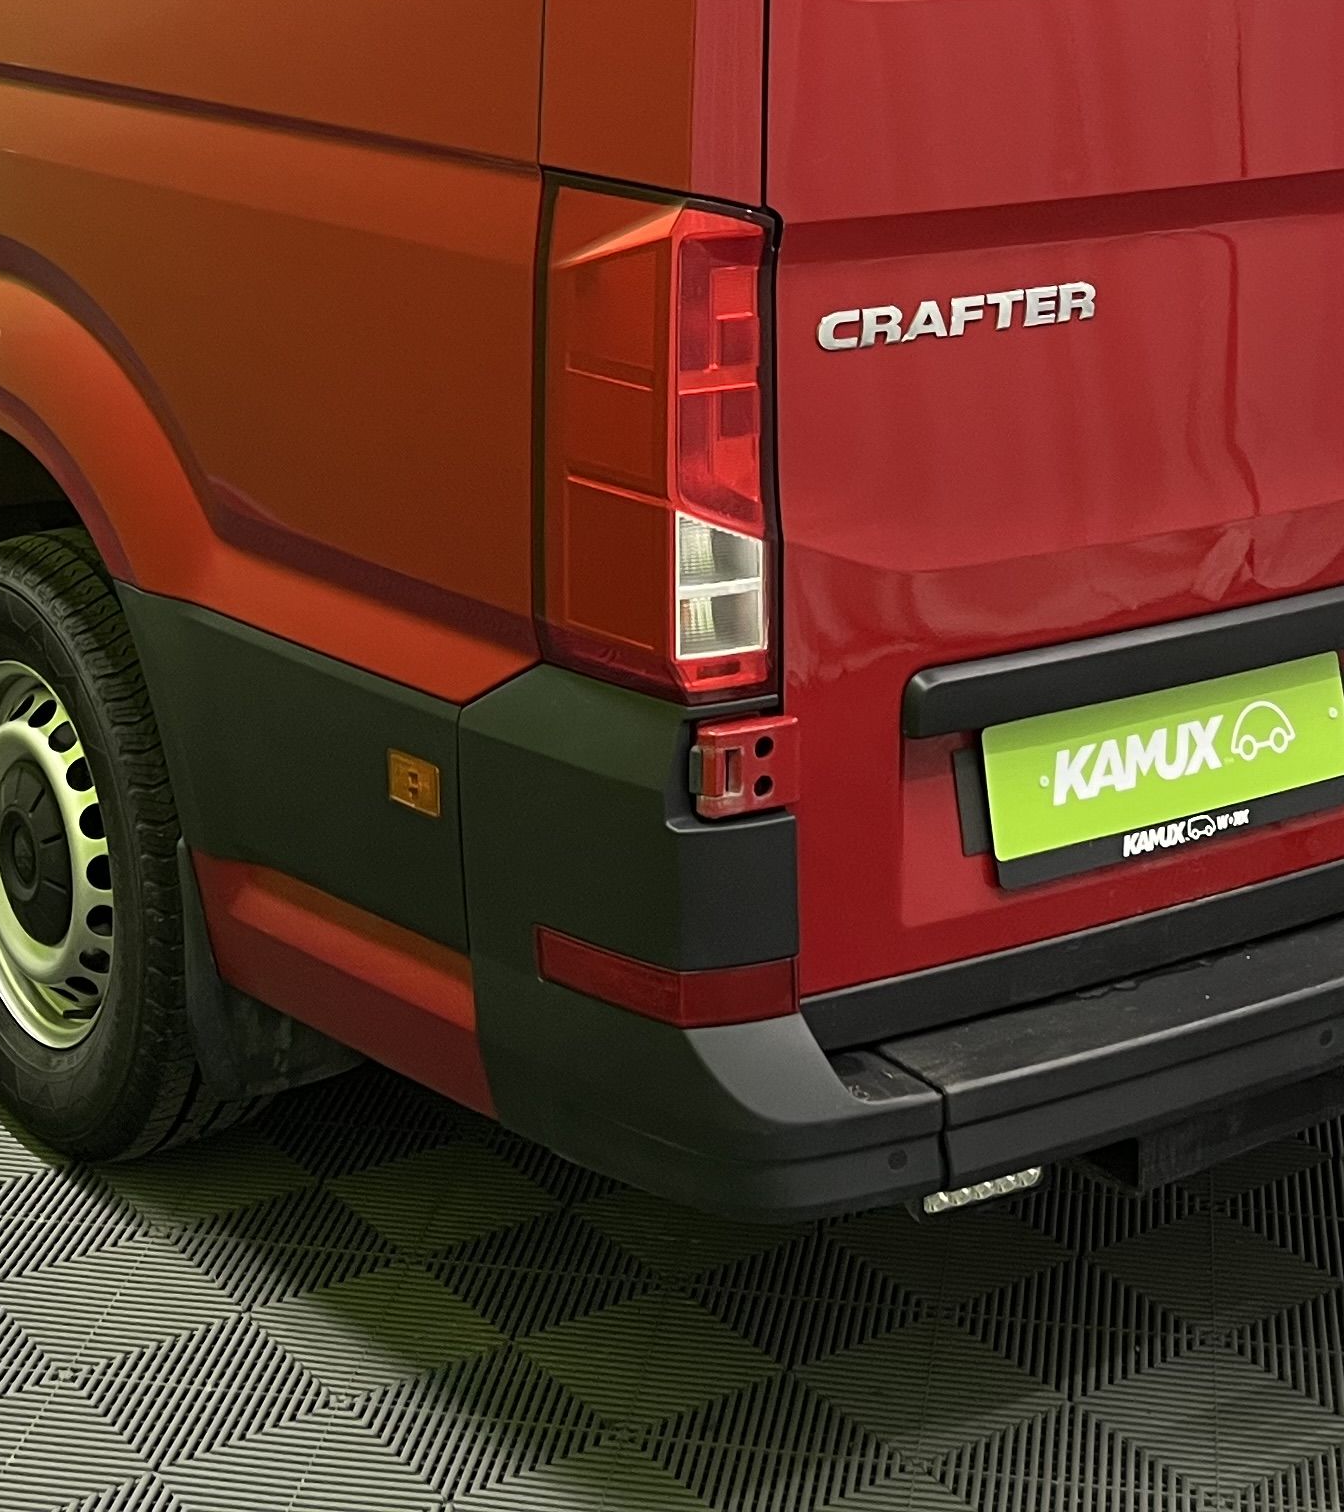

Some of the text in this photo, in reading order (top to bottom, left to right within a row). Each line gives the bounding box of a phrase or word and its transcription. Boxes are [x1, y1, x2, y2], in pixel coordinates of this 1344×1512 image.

[816, 281, 1096, 351] CRAFTER
[1053, 714, 1224, 806] KAMUX
[1123, 821, 1186, 857] KAMUX
